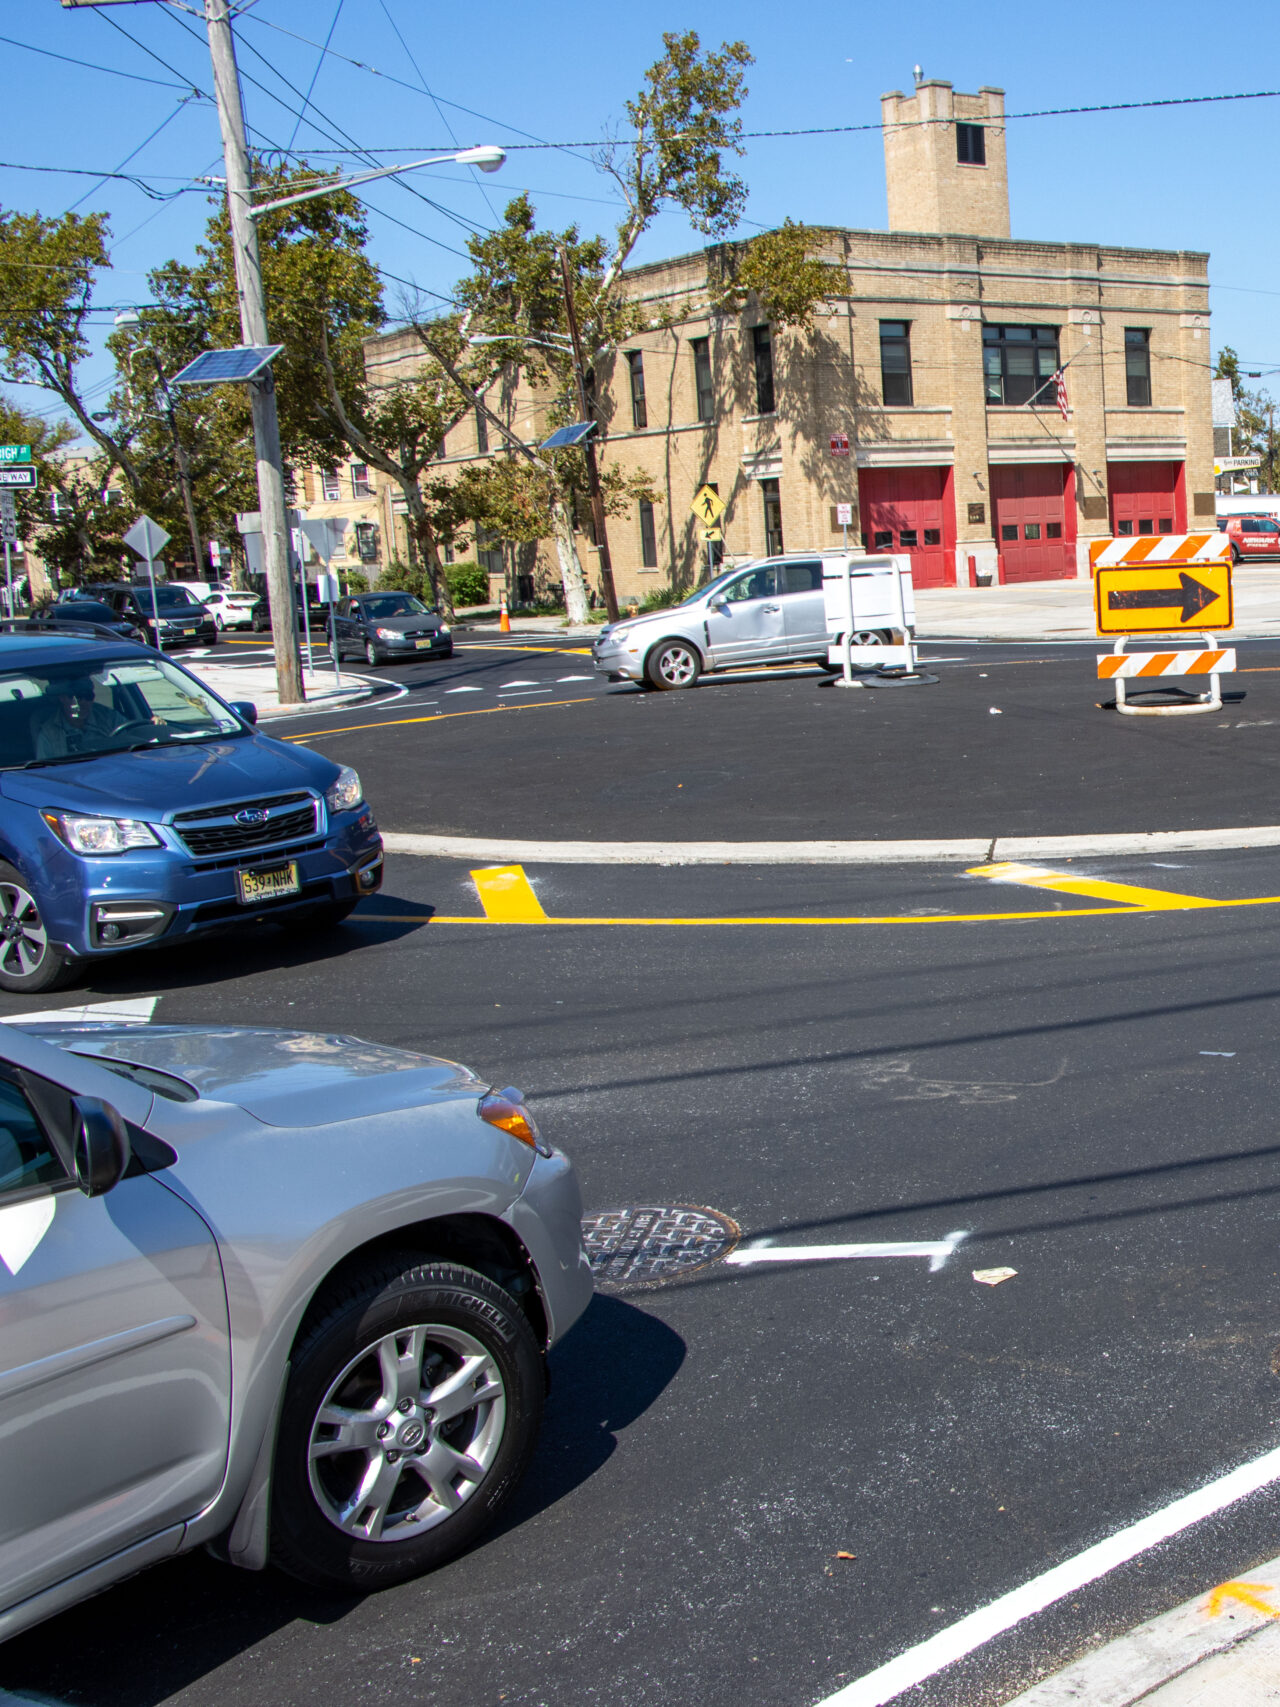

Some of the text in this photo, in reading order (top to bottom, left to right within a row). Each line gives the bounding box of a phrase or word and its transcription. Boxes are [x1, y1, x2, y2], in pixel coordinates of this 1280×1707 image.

[10, 473, 28, 481] WAY
[244, 875, 266, 894] S39
[272, 869, 294, 888] NHK
[439, 1289, 517, 1342] MICHELIN
